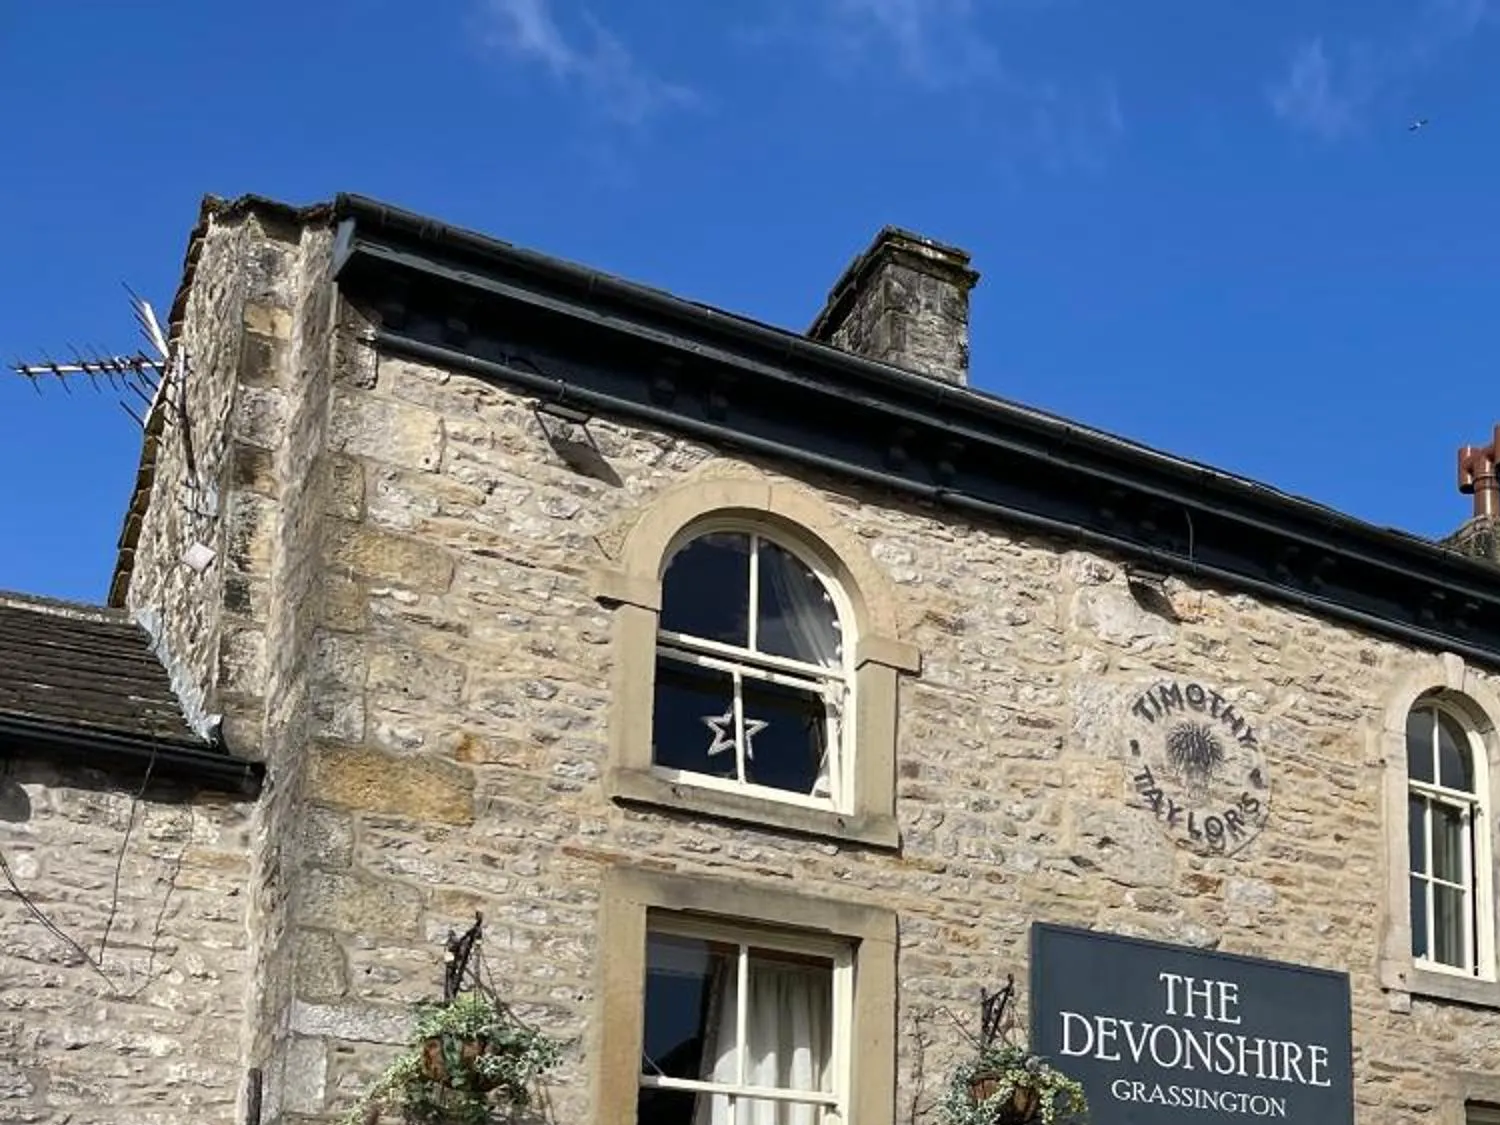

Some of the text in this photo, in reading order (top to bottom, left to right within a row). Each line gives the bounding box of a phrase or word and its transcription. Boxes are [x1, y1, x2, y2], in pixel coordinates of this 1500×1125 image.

[1132, 681, 1258, 744] TIMOTHY
[1159, 972, 1241, 1025] THE
[1059, 1012, 1331, 1087] DEVONSHIRE
[1111, 1079, 1286, 1118] GRASSINGTON
